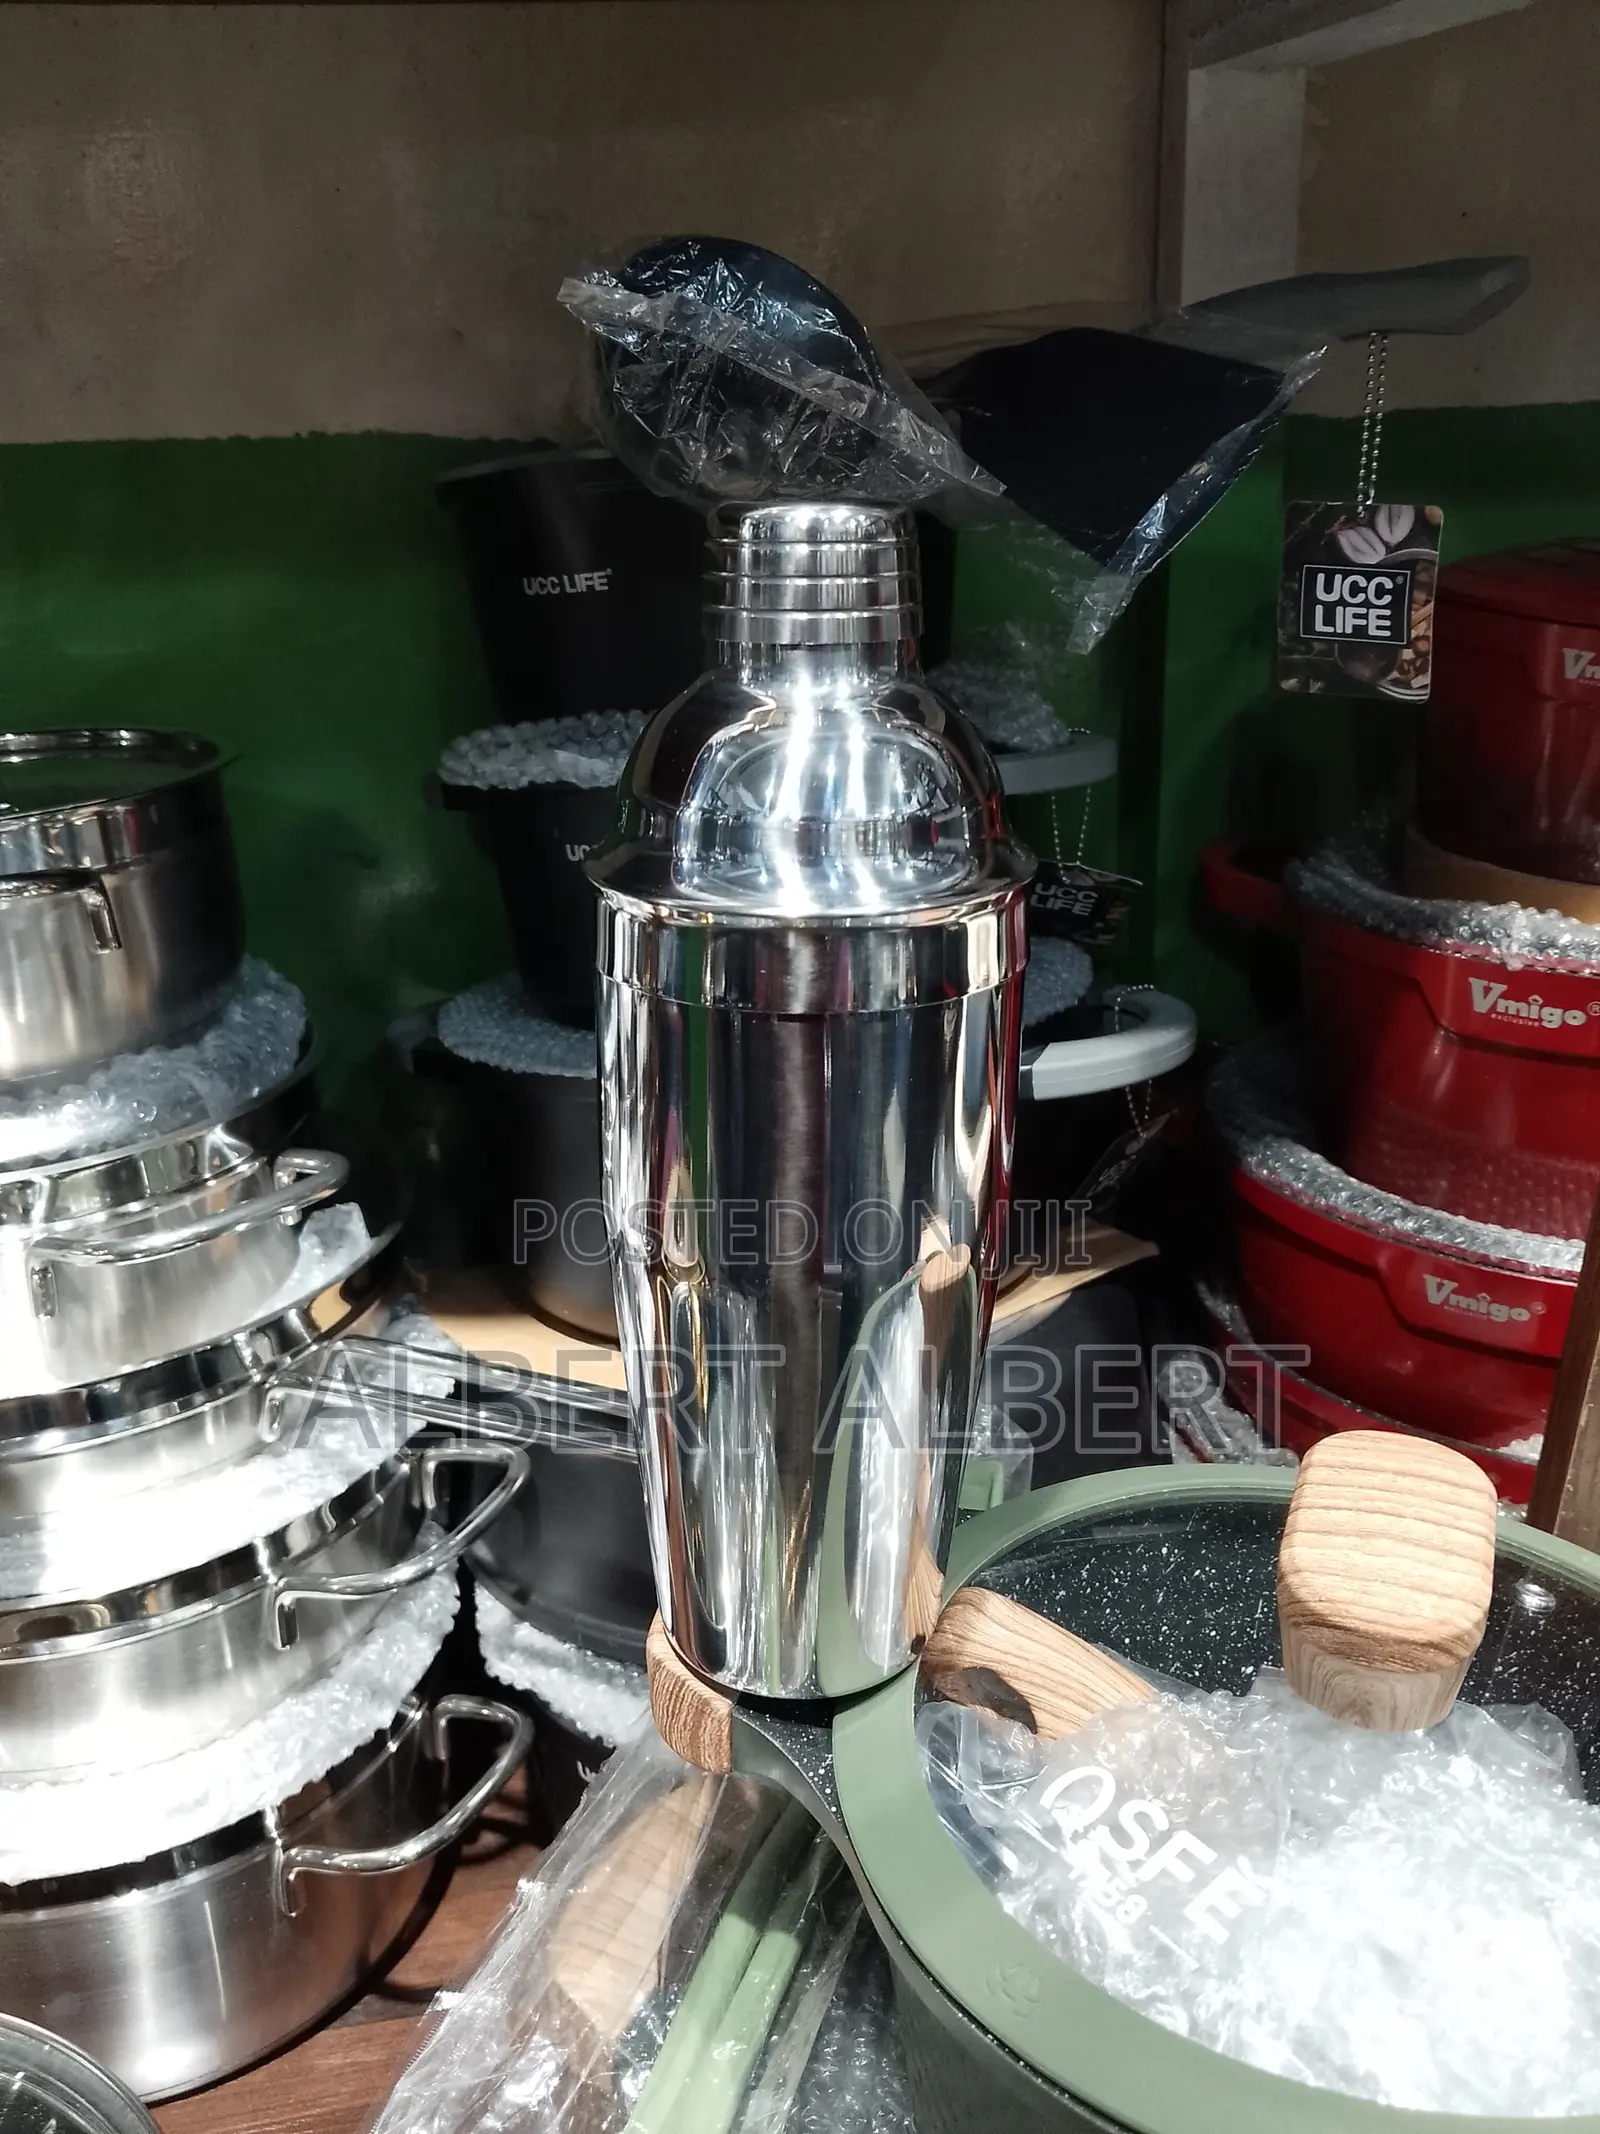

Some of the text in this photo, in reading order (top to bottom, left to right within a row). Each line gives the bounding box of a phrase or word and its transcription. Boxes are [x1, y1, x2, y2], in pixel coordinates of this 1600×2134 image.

[522, 571, 609, 596] UCC LIFE
[1315, 572, 1394, 606] UCC
[1314, 604, 1392, 637] LIFE
[565, 844, 591, 862] UC
[1030, 894, 1095, 916] LIFE
[1035, 883, 1099, 904] UCC
[1468, 977, 1587, 1028] Vmigo
[1422, 1273, 1532, 1323] Vmigo
